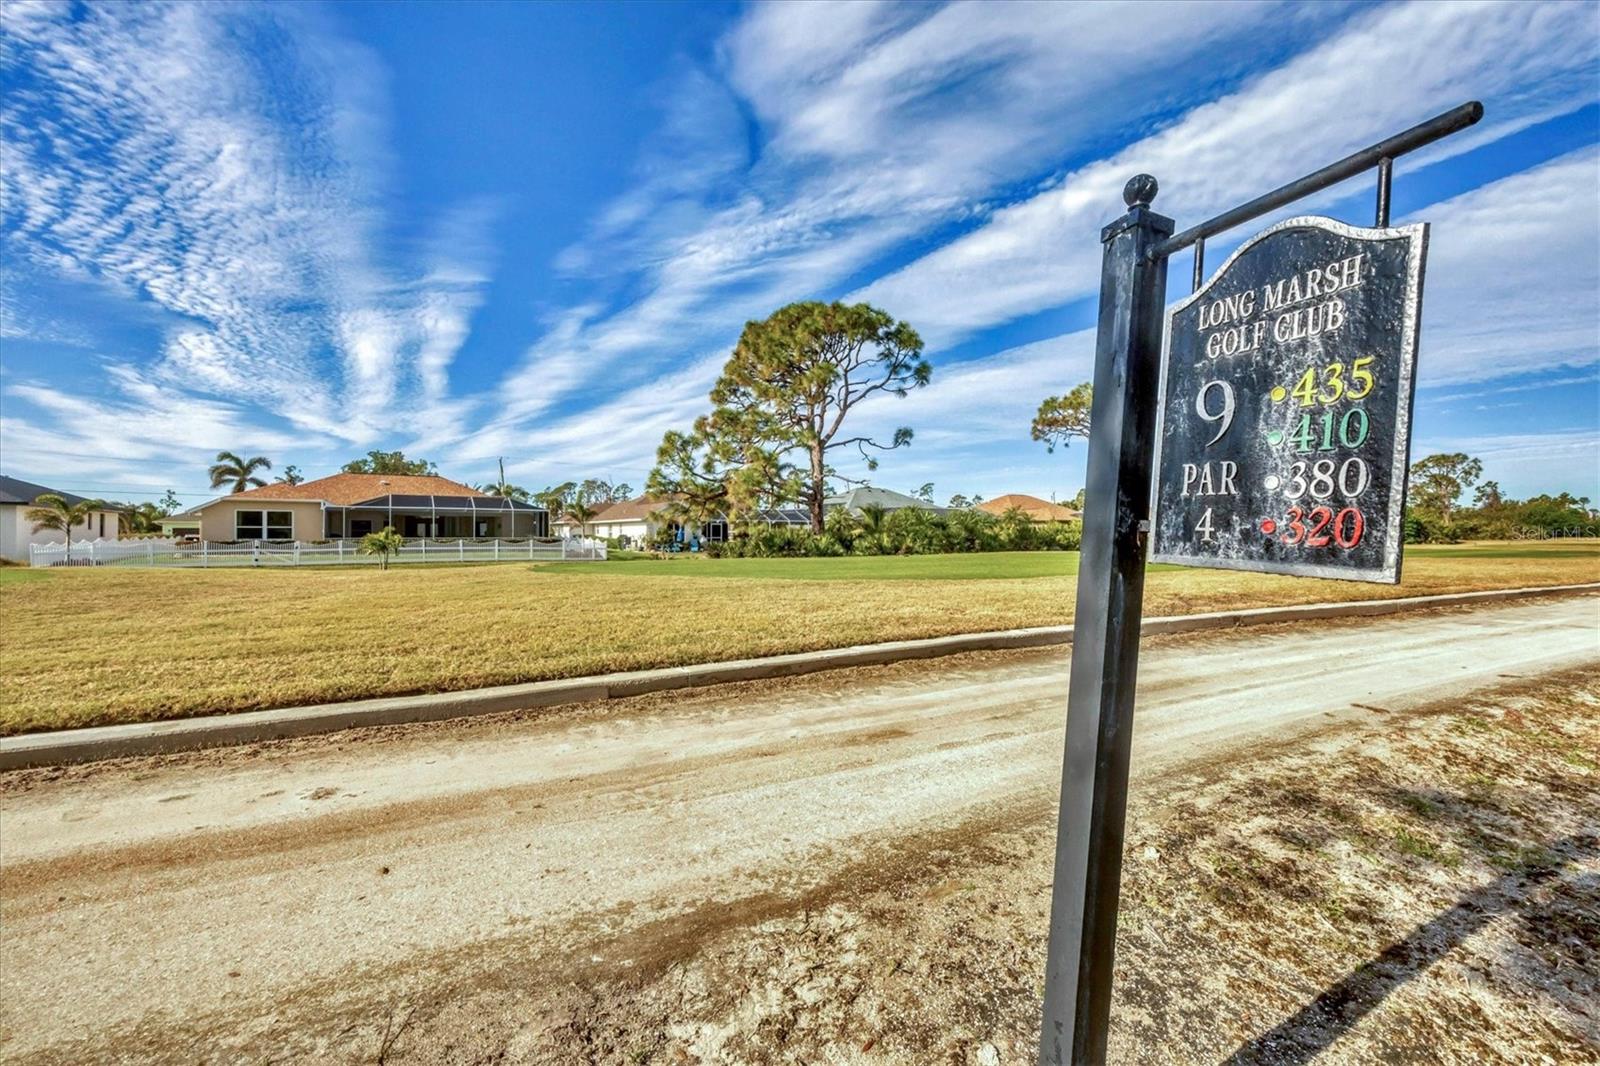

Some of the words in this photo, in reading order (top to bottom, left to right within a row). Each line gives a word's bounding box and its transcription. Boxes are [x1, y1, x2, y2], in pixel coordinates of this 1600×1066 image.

[1198, 289, 1255, 331] LONG
[1263, 254, 1365, 312] MARSH
[1207, 322, 1267, 359] GOLF
[1274, 299, 1345, 344] CLUB
[1291, 355, 1375, 407] 435
[1195, 380, 1236, 447] 9
[1289, 408, 1370, 453] 410
[1181, 461, 1239, 496] PAR
[1284, 457, 1372, 499] 380
[1195, 507, 1215, 544] 4
[1281, 506, 1364, 548] 320
